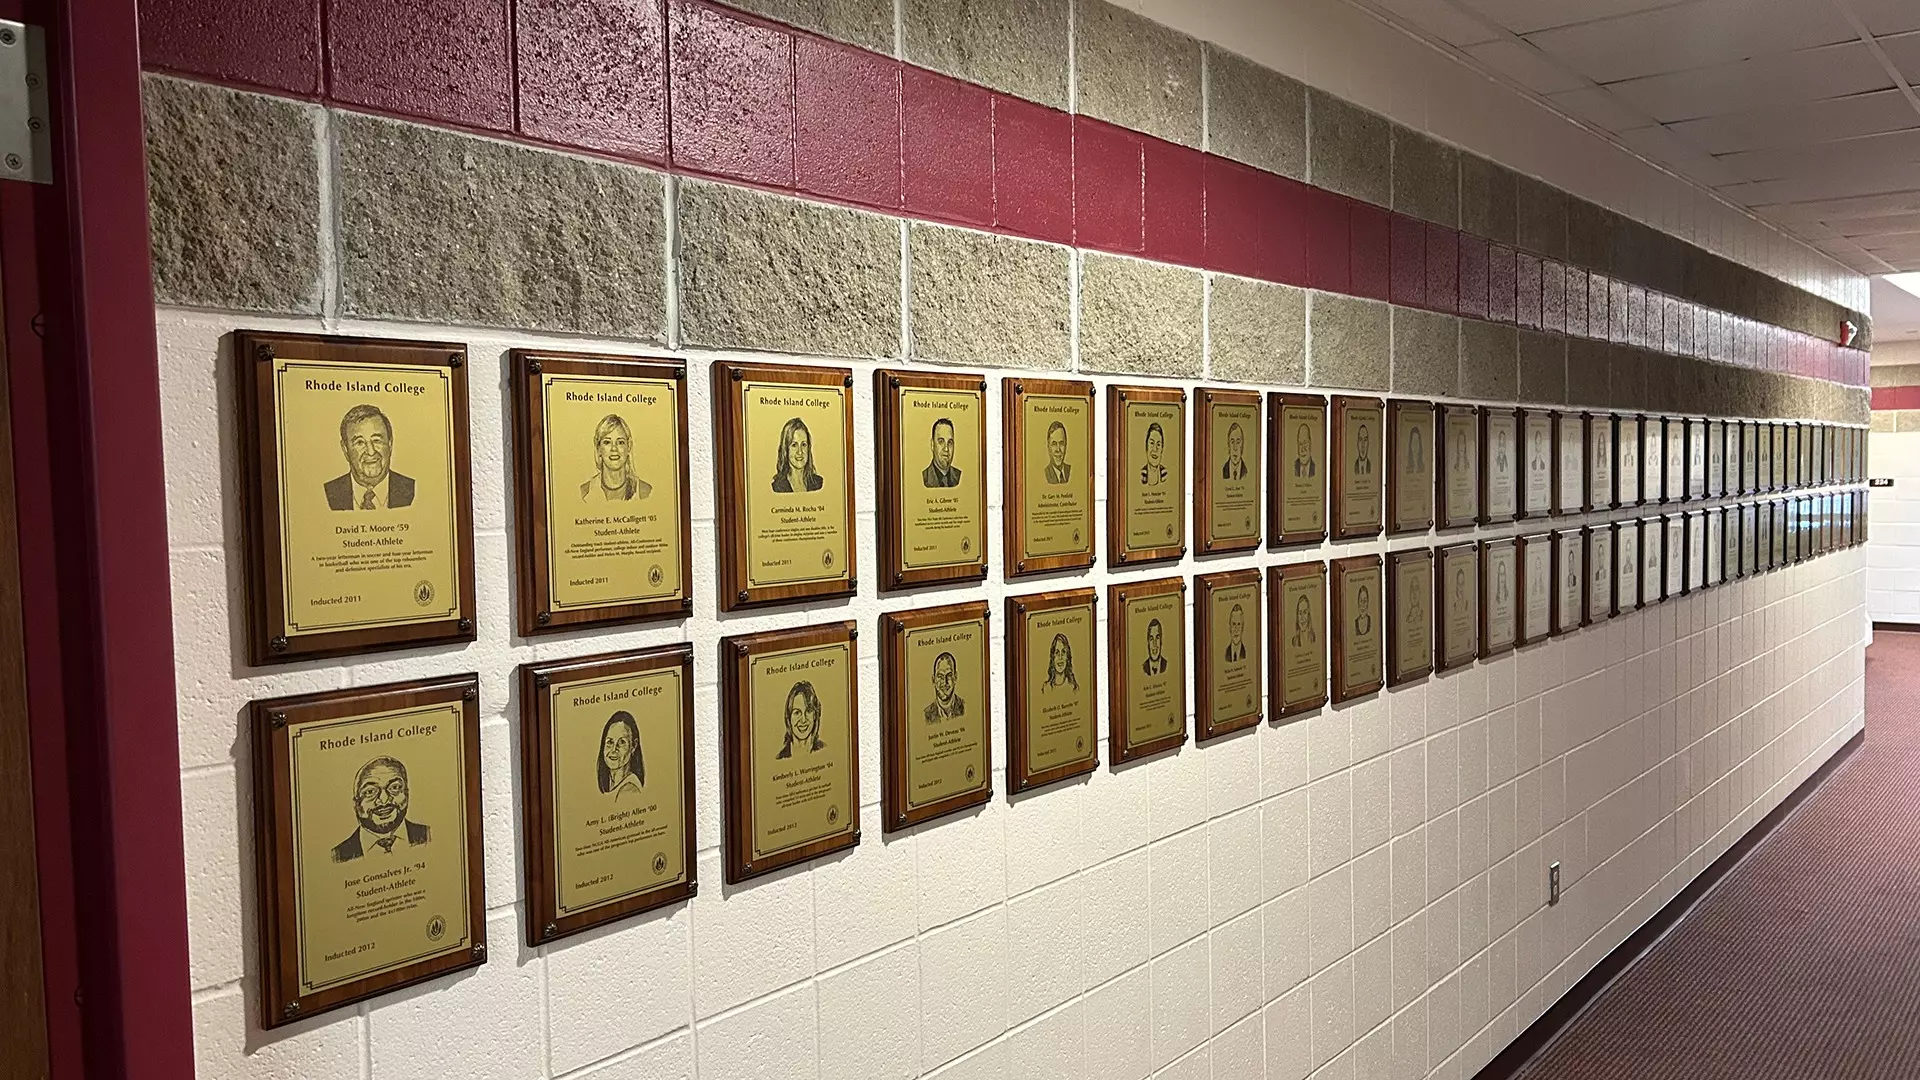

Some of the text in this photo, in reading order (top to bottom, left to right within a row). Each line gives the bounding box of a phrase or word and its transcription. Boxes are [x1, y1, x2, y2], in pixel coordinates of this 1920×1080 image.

[305, 380, 425, 395] Rhode Island College
[566, 392, 656, 405] Rhode Island College
[806, 399, 830, 408] College
[949, 402, 969, 411] College
[335, 526, 359, 534] David
[342, 538, 403, 547] Student-Athlete
[310, 597, 342, 605] Inducted
[766, 659, 835, 674] Rhode Island College
[573, 687, 662, 706] Rhode Island College
[320, 726, 437, 750] Rhode Island College
[608, 812, 630, 821] (Bright)
[599, 820, 644, 835] Student-Athlete
[344, 879, 361, 889] Jose
[363, 869, 402, 882] Gonsalves
[575, 874, 613, 889] Inducted 2012
[356, 880, 415, 898] Student-Athlete
[324, 942, 375, 961] Inducted 2012
